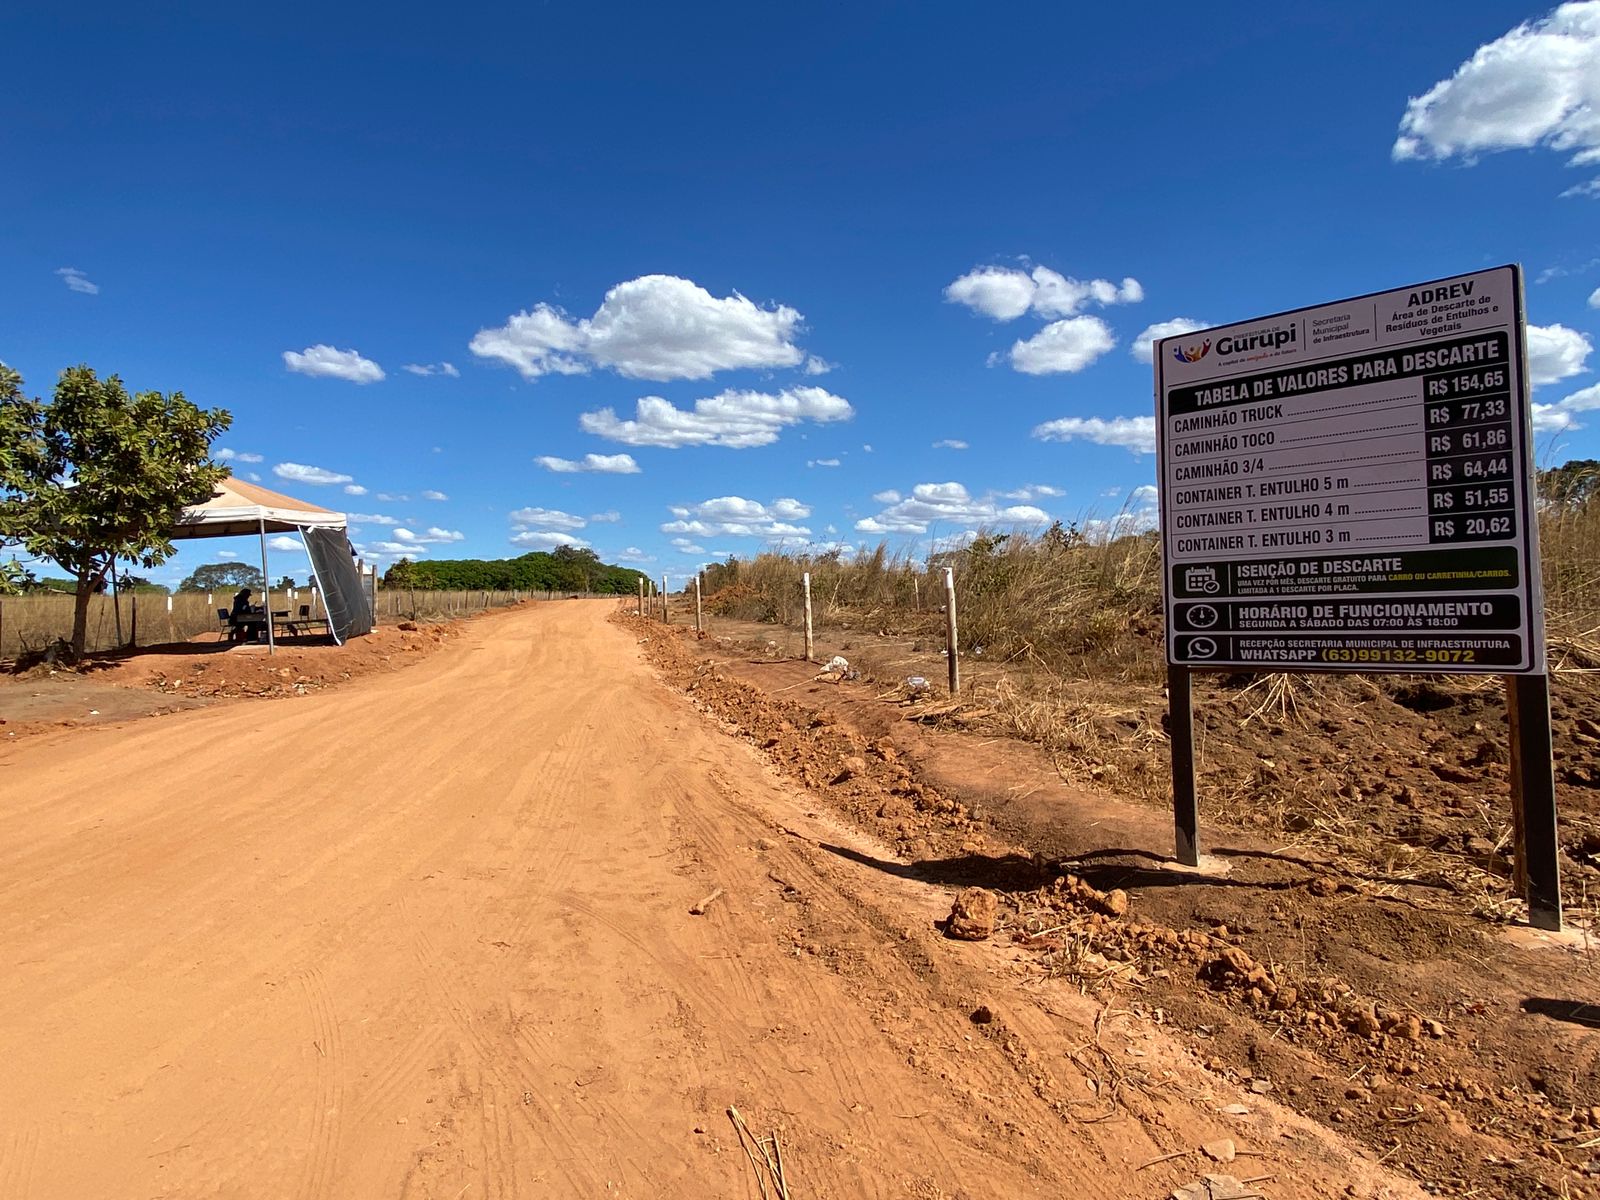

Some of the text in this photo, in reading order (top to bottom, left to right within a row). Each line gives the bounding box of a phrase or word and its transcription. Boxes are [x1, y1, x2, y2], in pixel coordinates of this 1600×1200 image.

[1407, 280, 1474, 307] ADREV
[1312, 314, 1351, 327] Secretaria
[1385, 305, 1499, 333] Resíduos de Entulhos e
[1392, 295, 1491, 322] Área de Descarte de
[1216, 323, 1296, 355] Gurupi
[1312, 322, 1349, 336] Municipal
[1313, 328, 1369, 344] de Infraestrutura
[1420, 321, 1461, 337] Vegetais
[1195, 339, 1499, 406] TABELA DE VALORES PARA DESCARTE
[1174, 370, 1503, 433] CAMINHÃO TRUCK R$ 154,65
[1175, 400, 1505, 457] CAMINHÃO TOCO R$ 77,33
[1175, 429, 1507, 481] CAMINHÃO 3/4 R$ 61,86
[1176, 458, 1508, 505] CONTAINER T. ENTULHO 5 m R$ 64,44
[1177, 488, 1509, 529] CONTAINER T. ENTULHO 4 m R$ 51,55
[1177, 517, 1510, 553] CONTAINER T. ENTULHO 3 m R$ 20,62
[1237, 557, 1402, 578] ISENÇÃO DE DESCARTE
[1297, 577, 1332, 585] DESCARTE
[1333, 575, 1366, 584] GRATUITO
[1368, 574, 1387, 582] PARA
[1388, 573, 1413, 581] CARRO
[1237, 586, 1268, 595] LIMITADA
[1281, 585, 1317, 594] DESCARTE
[1317, 585, 1333, 593] POR
[1239, 602, 1493, 619] HORÁRIO DE FUNCIONAMENTO
[1239, 616, 1459, 628] SEGUNDA A SÁBADO DAS 07:00 ÀS 18:00
[1240, 638, 1510, 650] RECEPÇÃO SECRETARIA MUNICIPAL DE INFRAESTRUTURA
[1240, 649, 1475, 663] WHATSAPP (63)99132-9072
